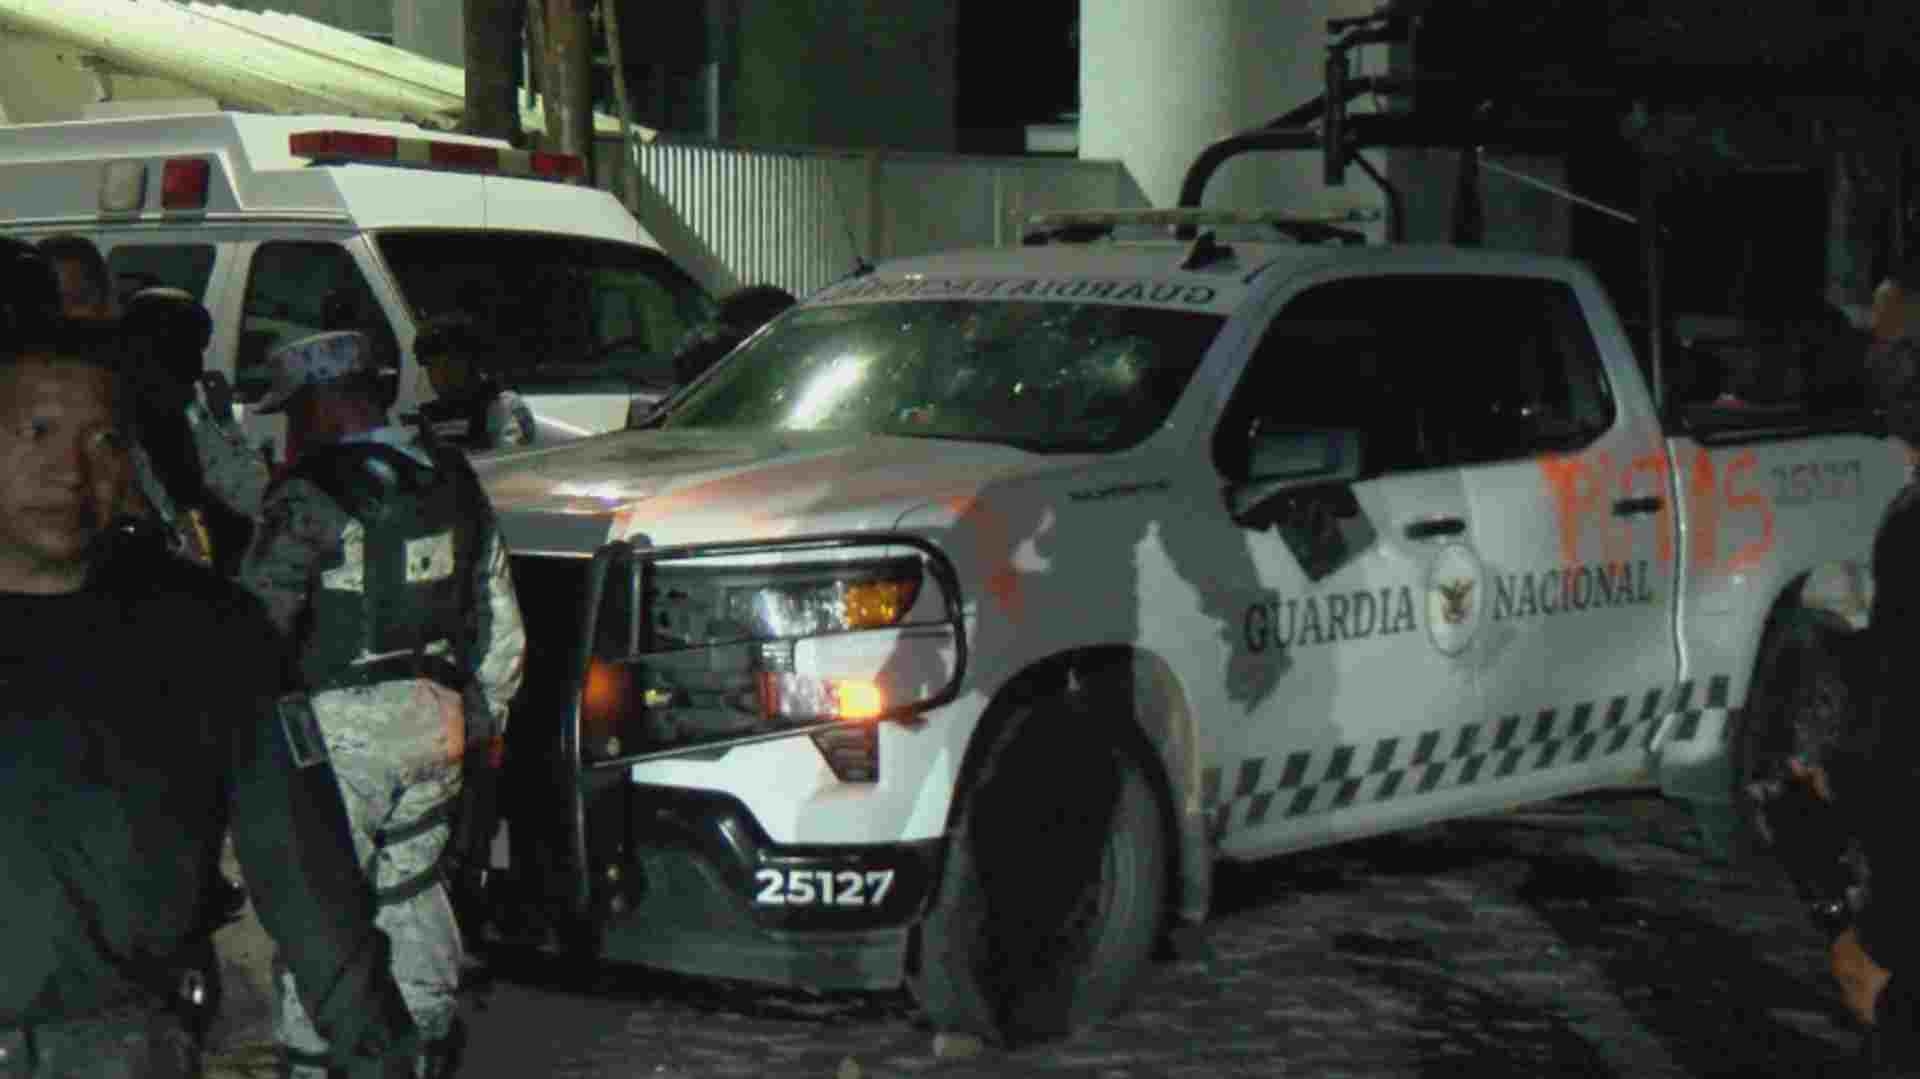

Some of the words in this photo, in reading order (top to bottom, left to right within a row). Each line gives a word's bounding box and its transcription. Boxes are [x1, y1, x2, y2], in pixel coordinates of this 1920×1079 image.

[1244, 585, 1417, 653] GUARDIA
[1493, 559, 1652, 621] NACIONAL
[755, 869, 895, 905] 25127
